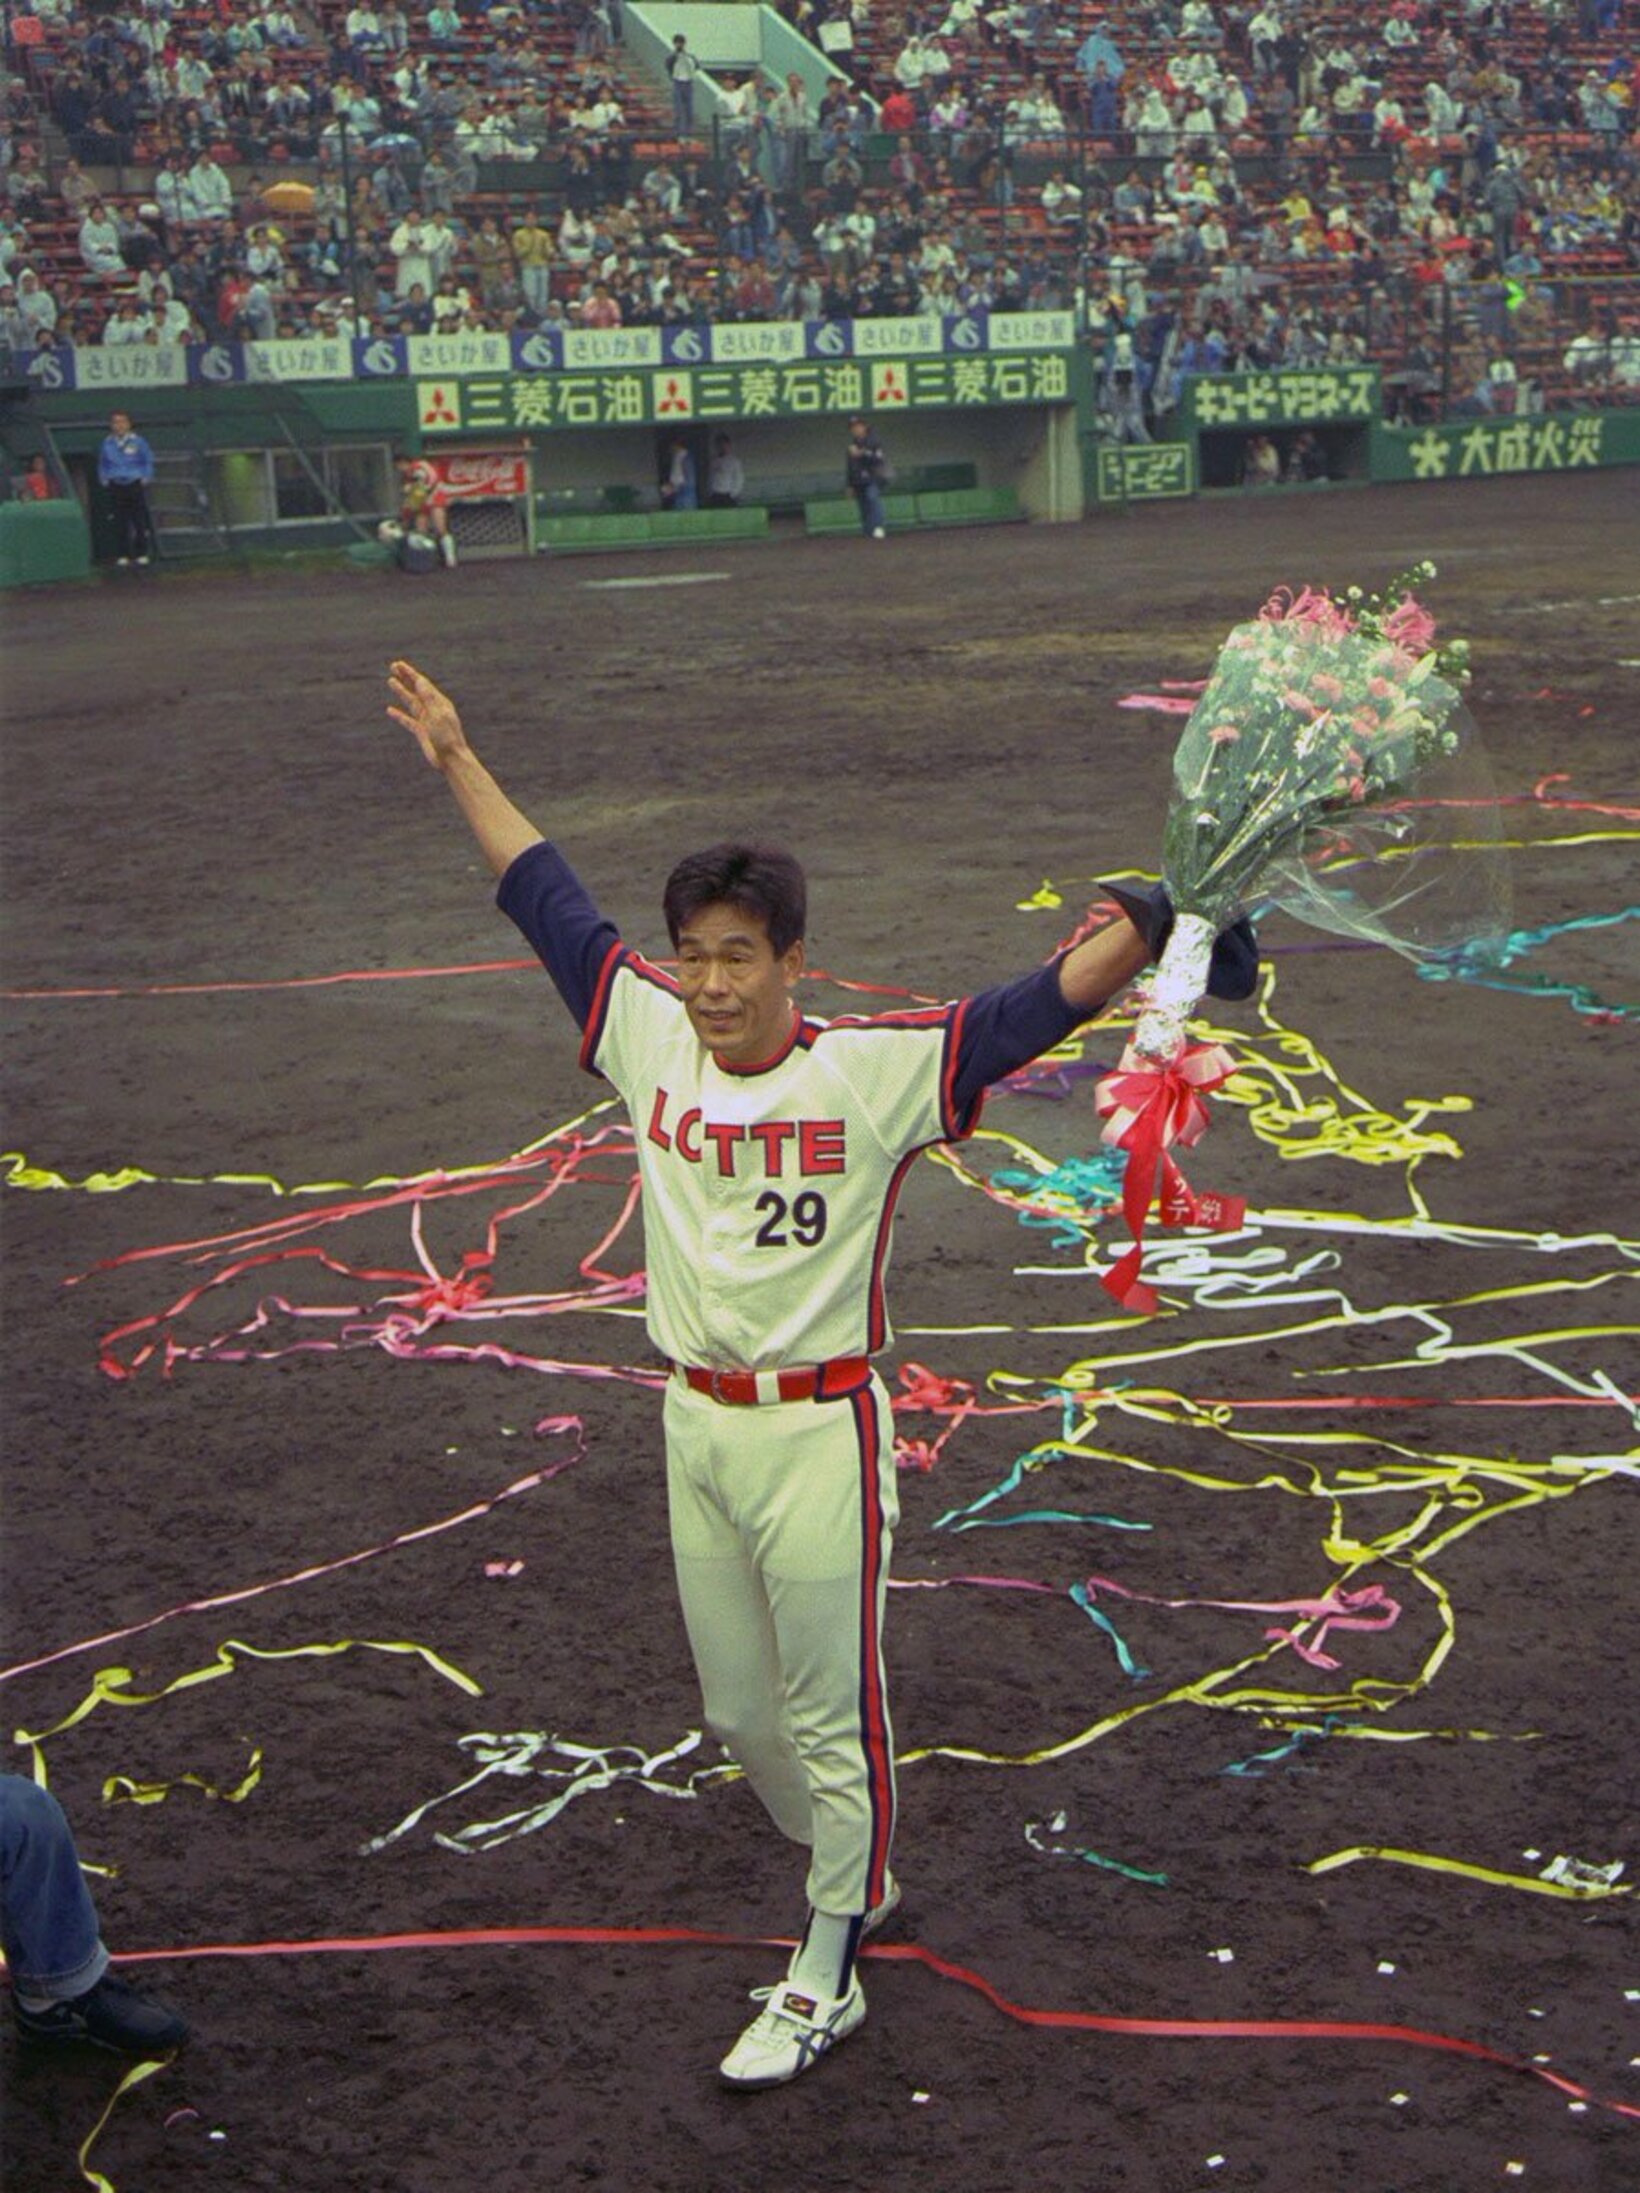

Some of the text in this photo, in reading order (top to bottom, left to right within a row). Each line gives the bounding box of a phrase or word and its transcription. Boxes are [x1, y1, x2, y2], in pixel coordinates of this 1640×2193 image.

[572, 333, 650, 361] さいか屋
[720, 327, 795, 353] さいか屋
[861, 320, 935, 345] さいか屋
[995, 317, 1065, 340] さいか屋
[418, 338, 499, 365] さいか屋
[699, 364, 863, 416] 三菱石油
[913, 354, 1068, 404] 三菱石油
[467, 374, 644, 427] 三菱石油
[1459, 417, 1603, 476] 大成火災
[754, 1189, 828, 1248] 29
